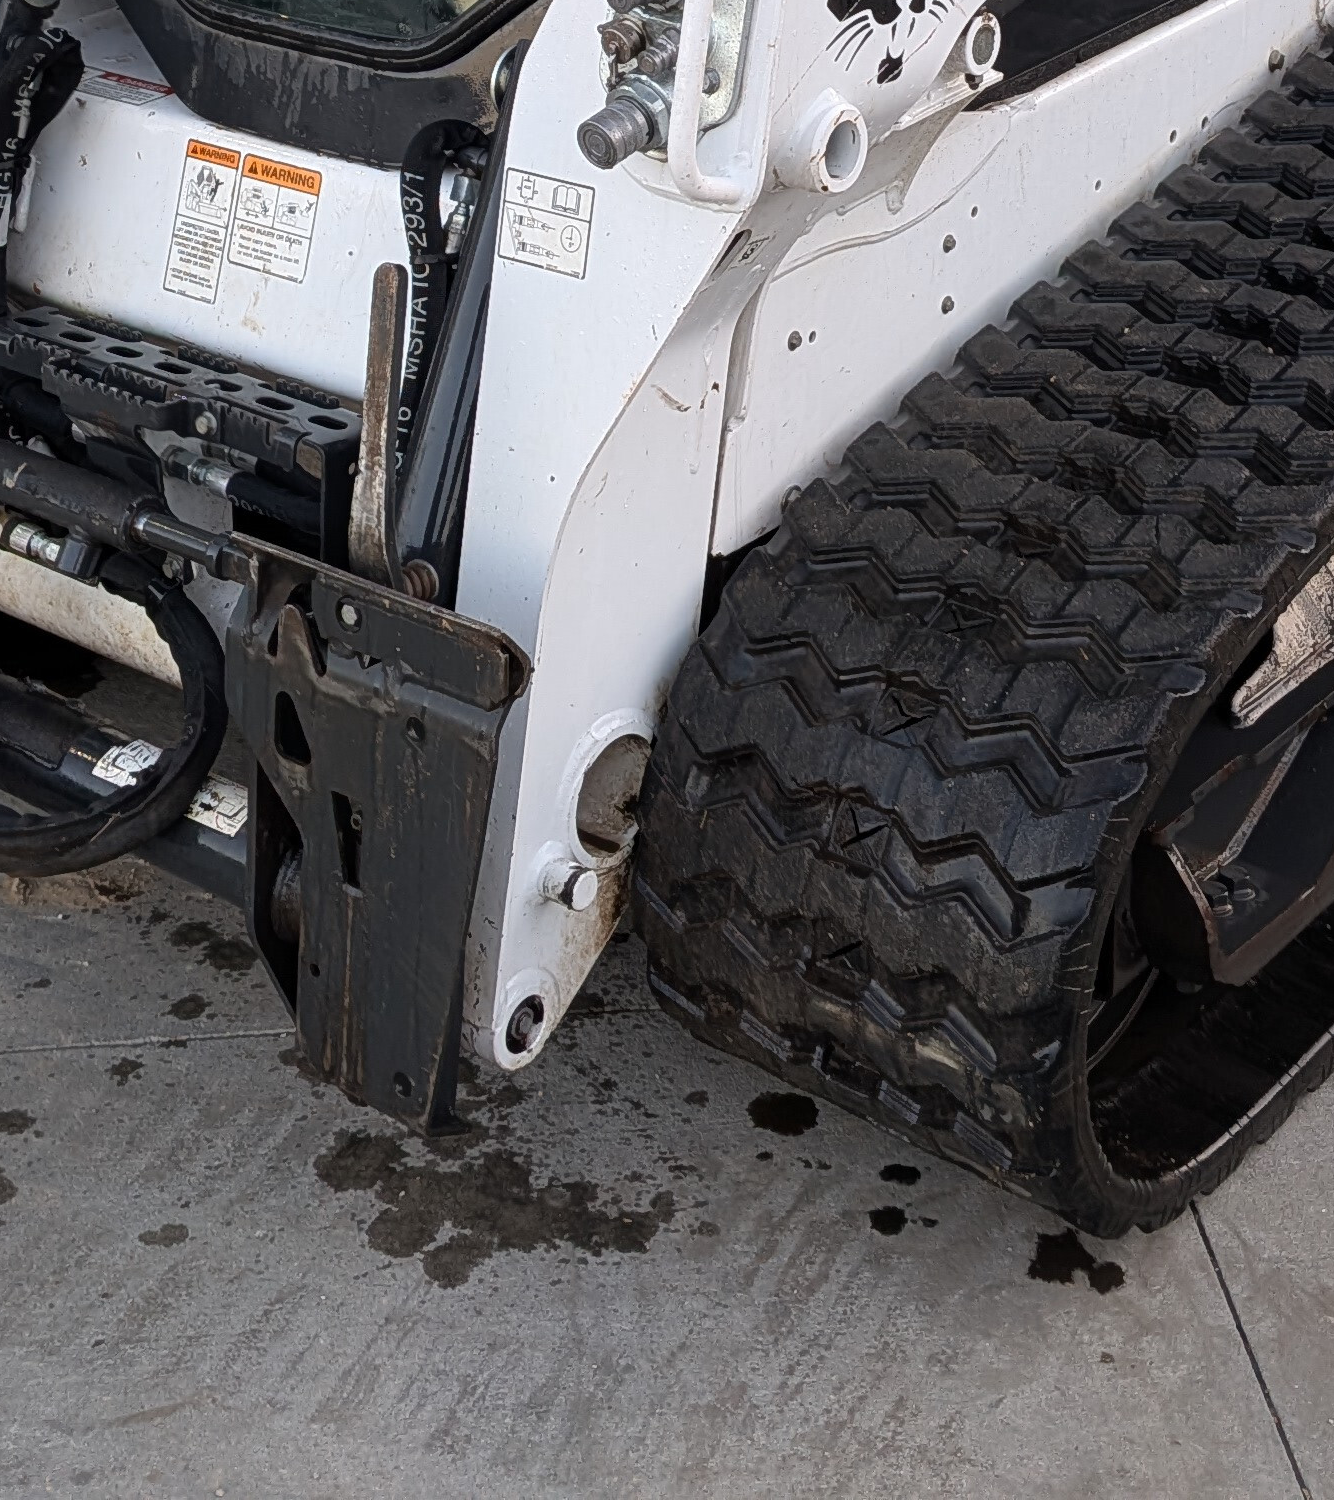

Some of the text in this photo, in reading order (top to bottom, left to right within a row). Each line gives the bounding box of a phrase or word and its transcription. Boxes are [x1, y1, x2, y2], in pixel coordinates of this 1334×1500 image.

[199, 145, 235, 164] WARNING
[260, 163, 315, 189] WARNING
[404, 296, 429, 380] MSHA
